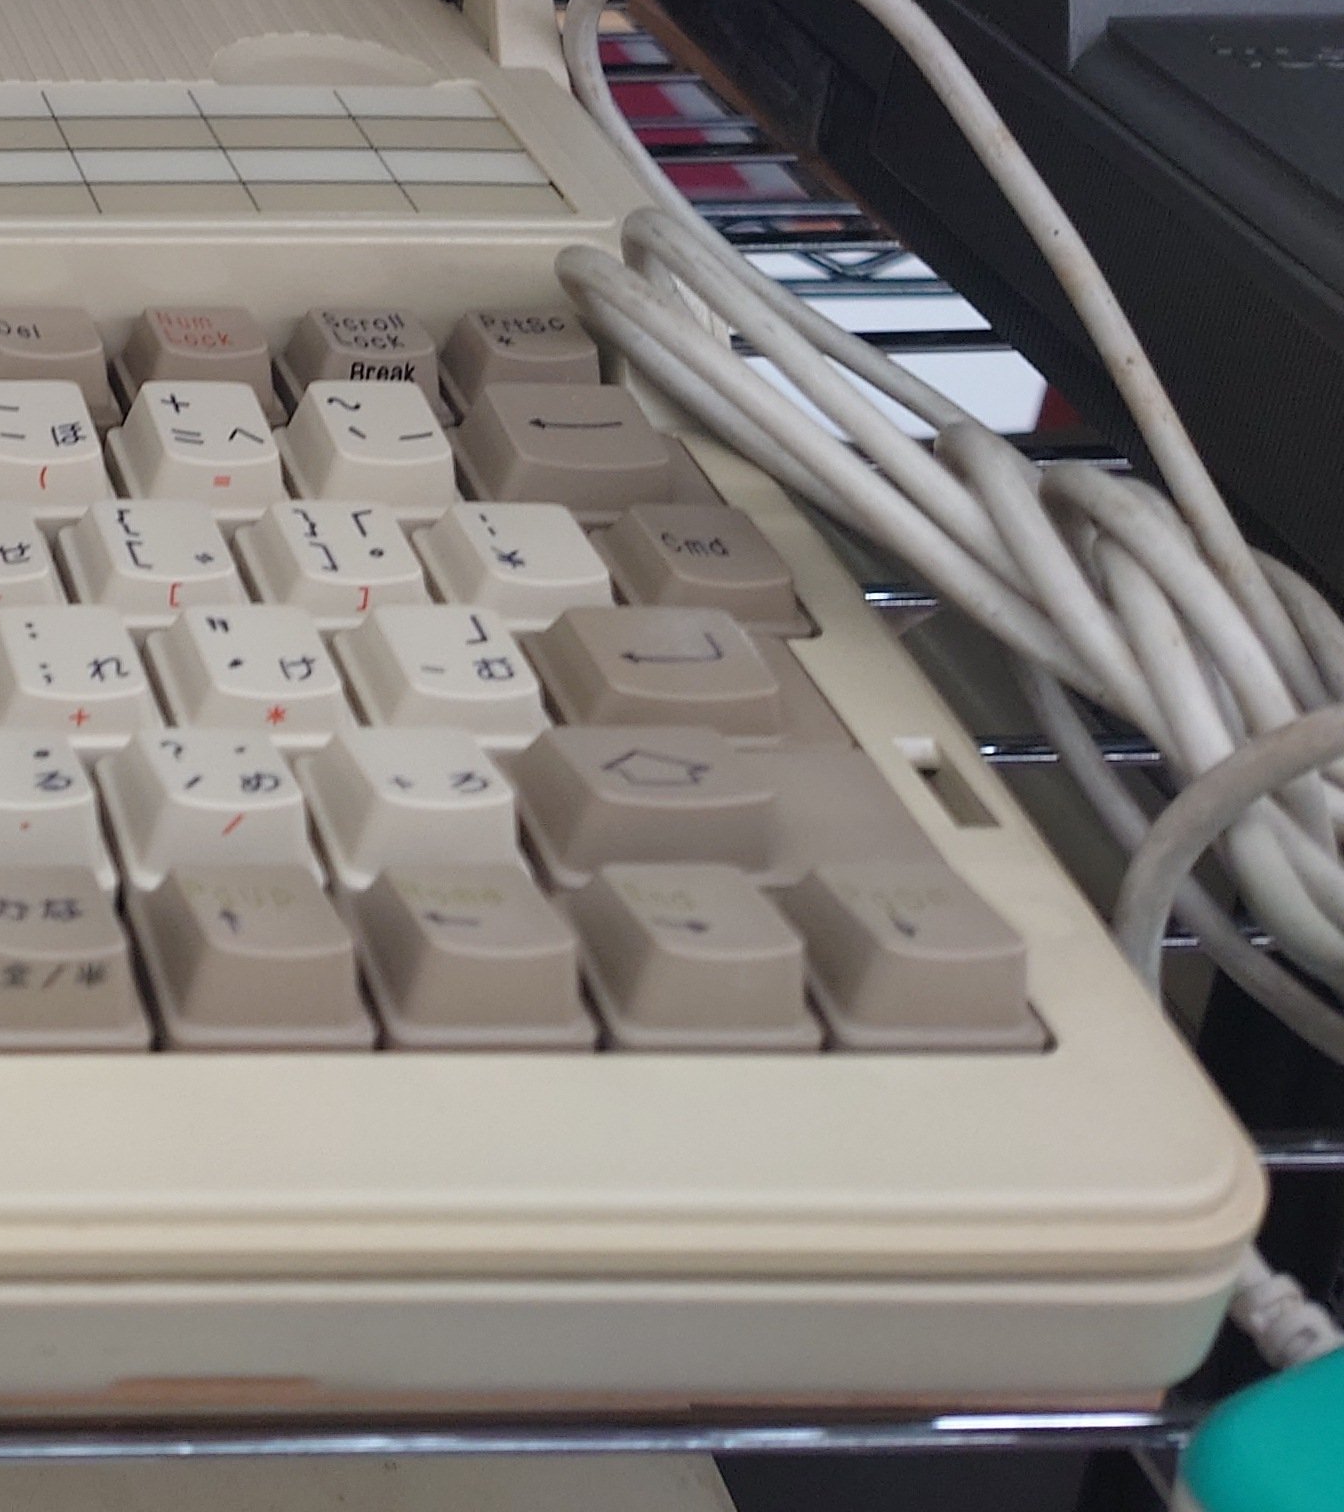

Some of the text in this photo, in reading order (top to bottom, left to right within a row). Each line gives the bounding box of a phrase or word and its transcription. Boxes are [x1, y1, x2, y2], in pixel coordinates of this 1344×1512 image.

[165, 324, 229, 346] Lock
[318, 312, 405, 336] Scroll
[479, 314, 566, 334] PrtSc
[333, 325, 404, 349] Lock
[350, 362, 415, 382] Break
[51, 423, 85, 446] ほ
[661, 532, 729, 556] Cmd
[90, 658, 128, 681] れ
